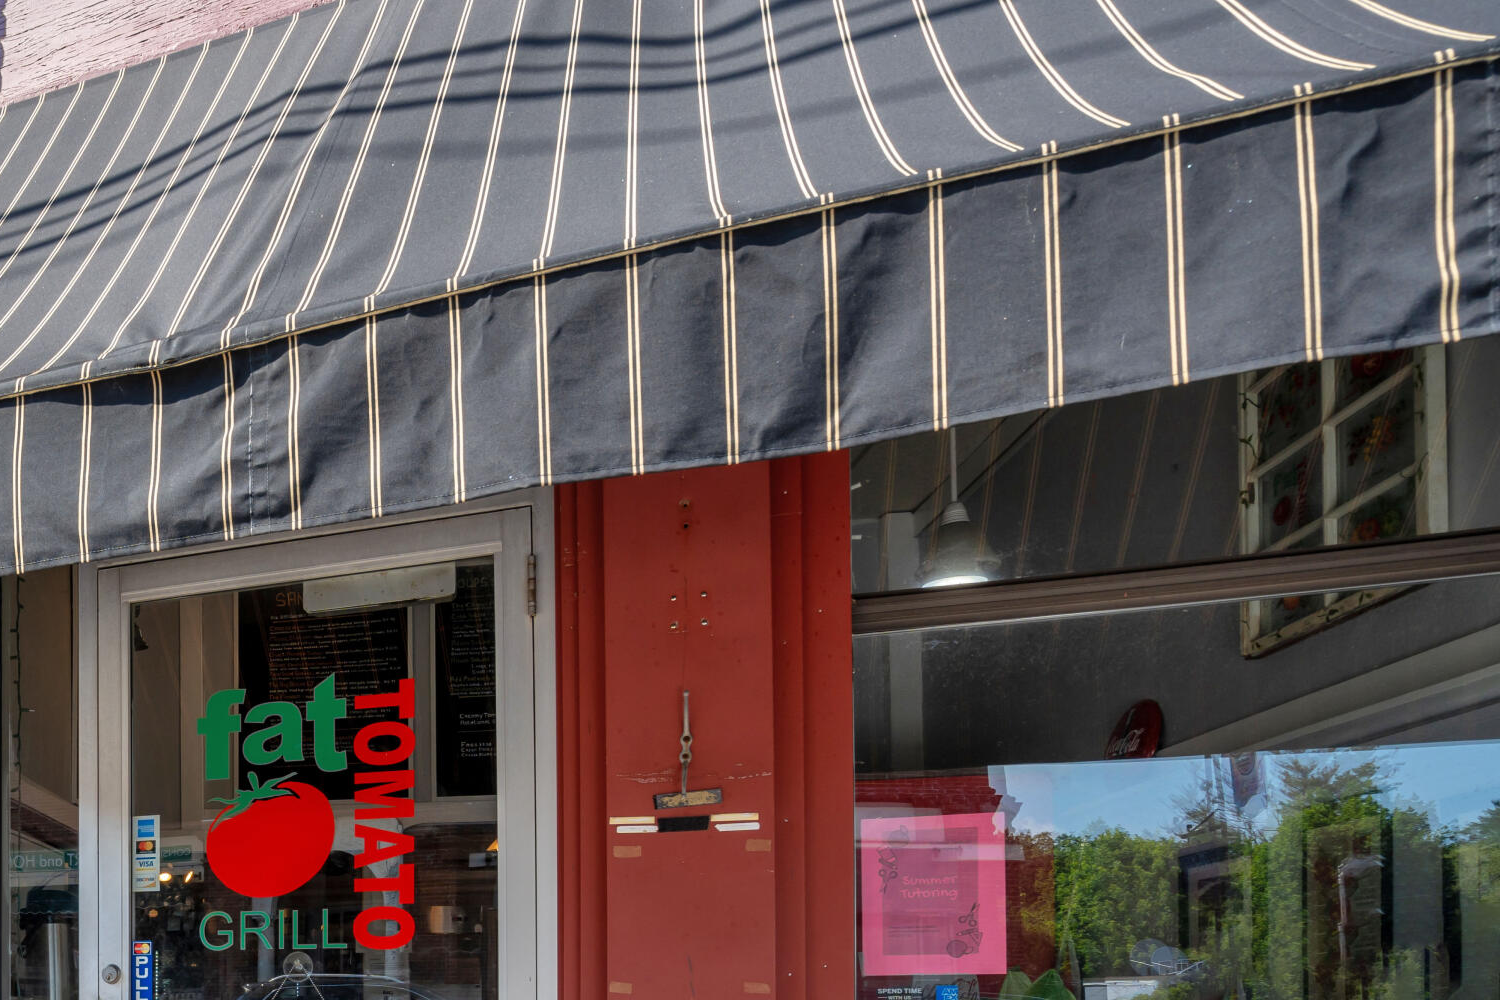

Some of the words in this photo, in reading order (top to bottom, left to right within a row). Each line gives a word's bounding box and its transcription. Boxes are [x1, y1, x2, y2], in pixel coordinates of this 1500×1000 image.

[197, 673, 347, 780] fat
[353, 678, 415, 950] TOMATO
[900, 888, 958, 901] Tutoring
[902, 876, 957, 885] Summer
[199, 909, 347, 951] GRILL
[135, 956, 148, 1000] PULL
